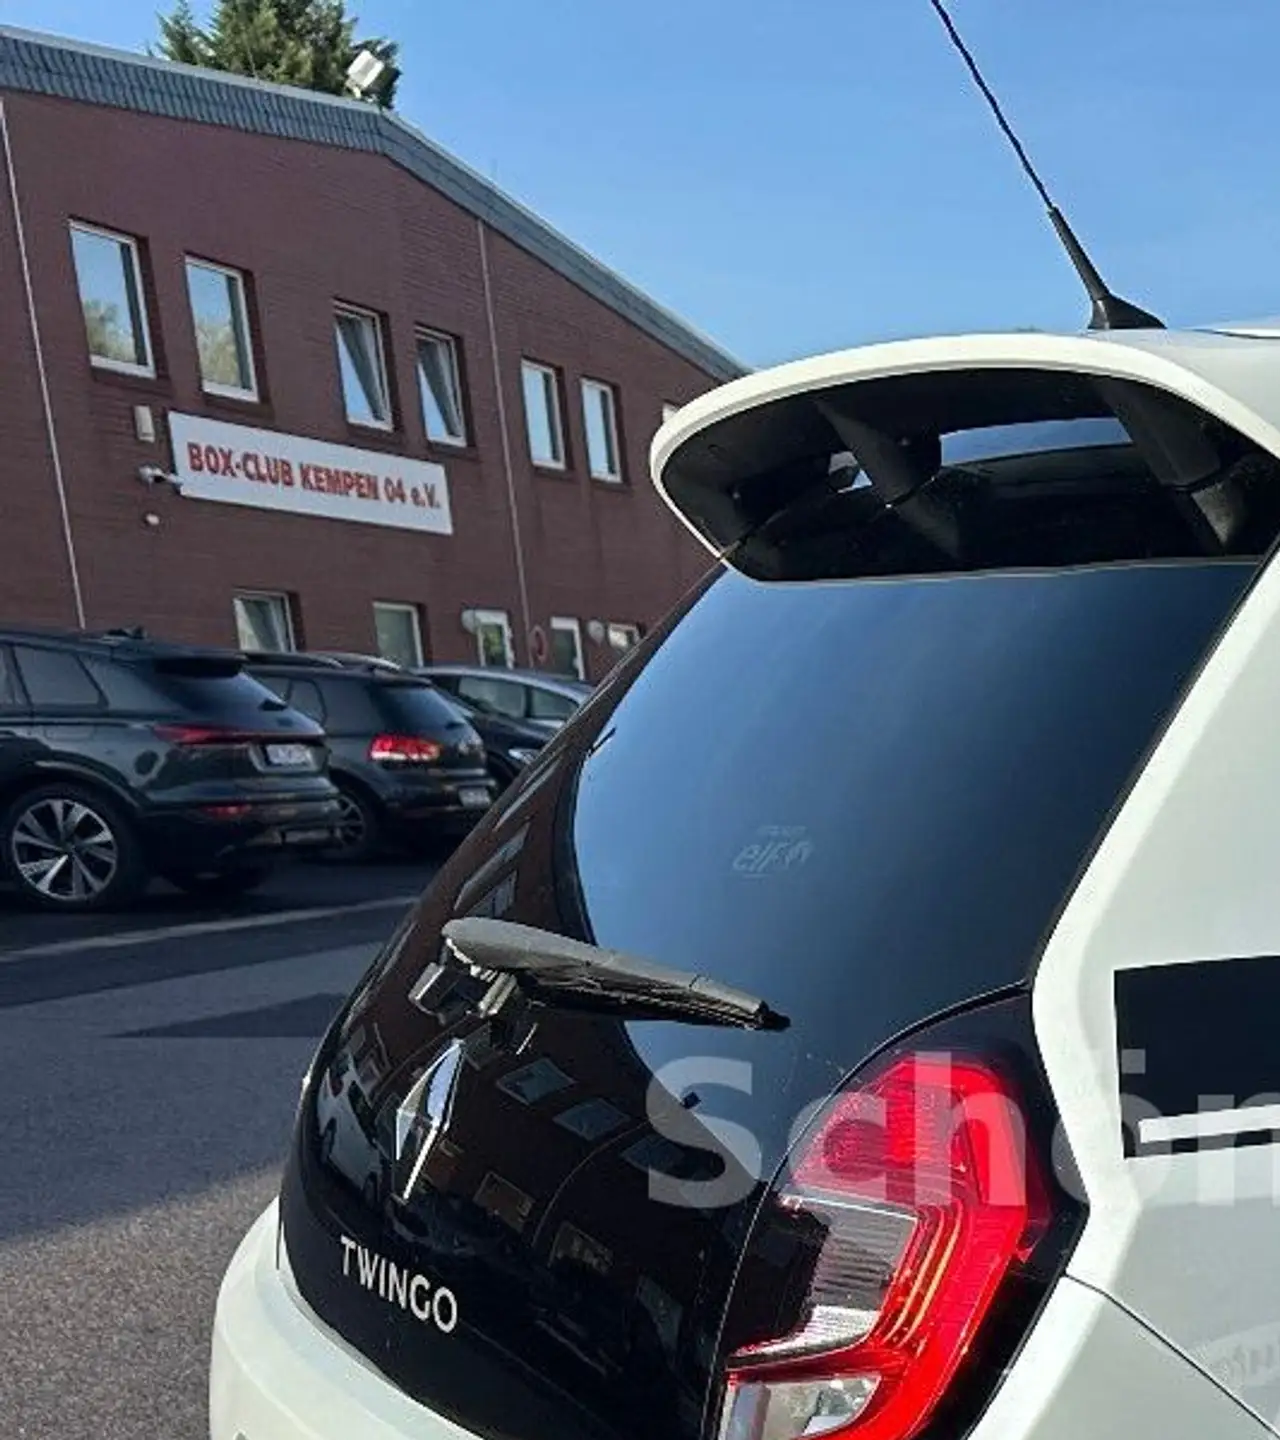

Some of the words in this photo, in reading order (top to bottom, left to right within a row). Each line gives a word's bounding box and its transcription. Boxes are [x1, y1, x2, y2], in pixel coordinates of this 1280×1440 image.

[187, 441, 295, 488] BOX-CLUB
[299, 462, 381, 502] KEMPEN
[384, 476, 407, 506] 04
[411, 480, 441, 509] e.V.
[340, 1234, 458, 1334] TWINGO
